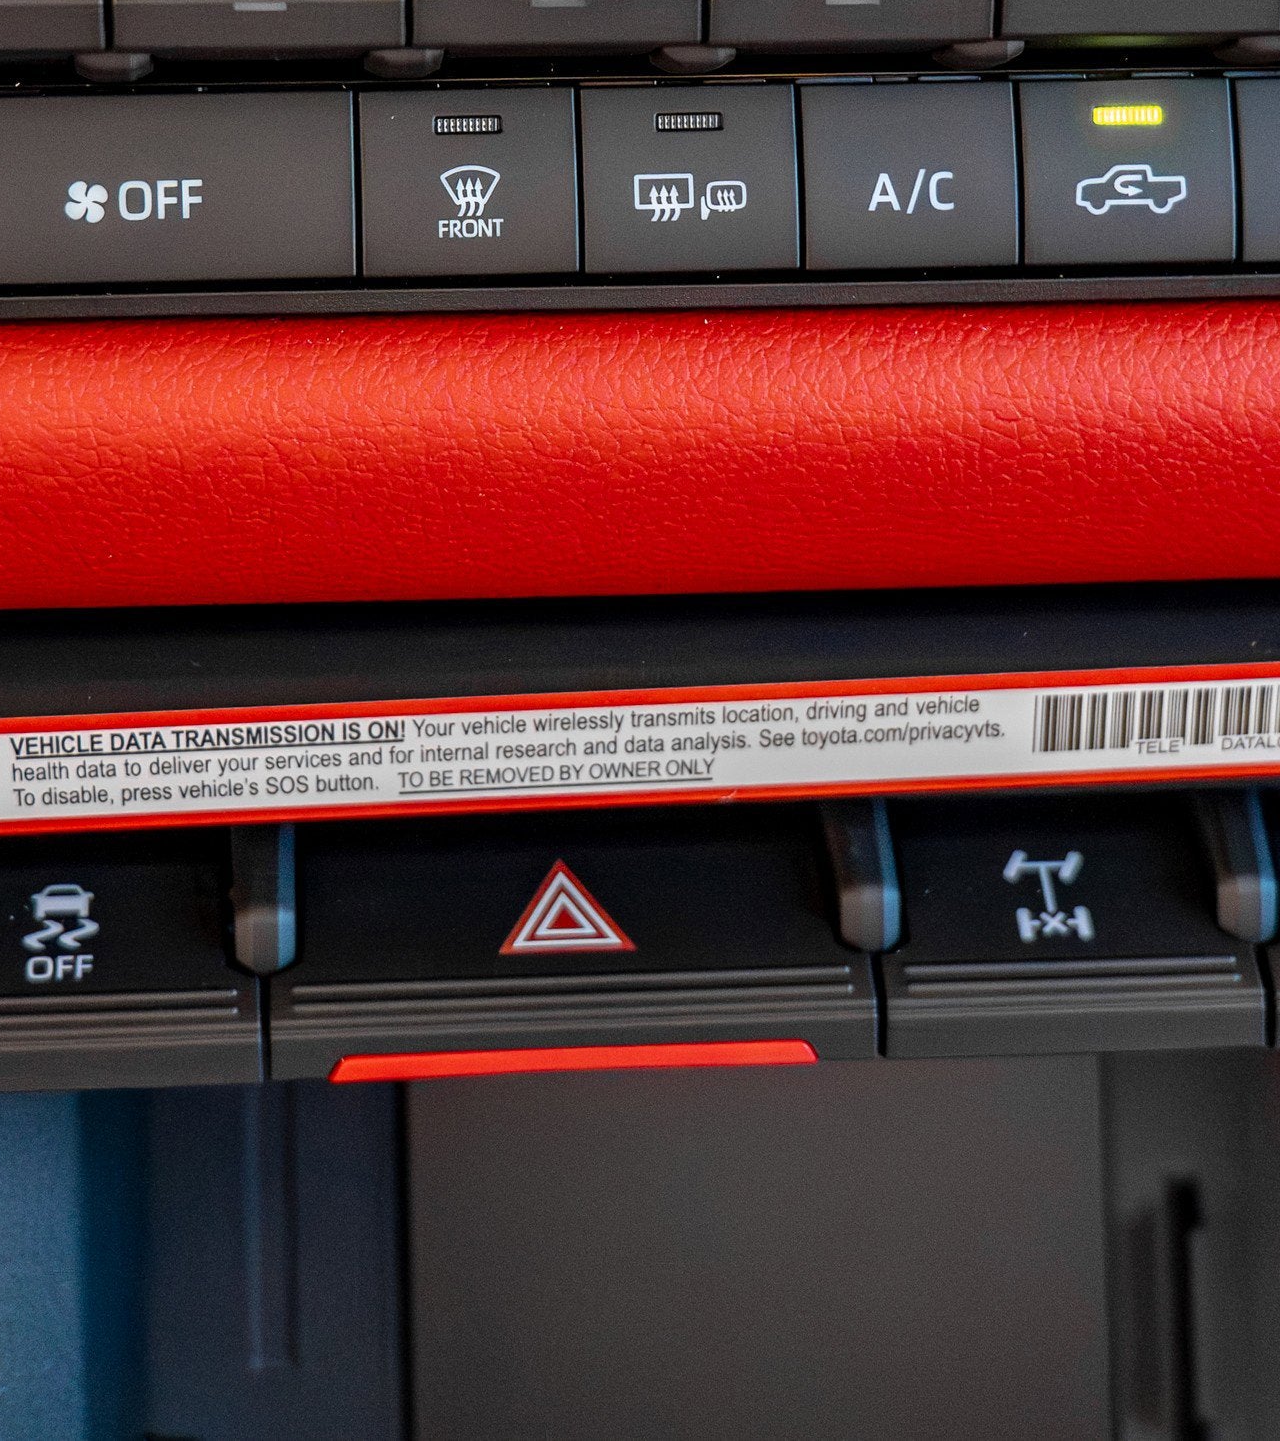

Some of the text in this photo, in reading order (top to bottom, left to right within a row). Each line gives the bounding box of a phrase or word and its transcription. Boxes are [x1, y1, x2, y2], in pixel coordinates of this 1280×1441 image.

[119, 178, 204, 221] OFF
[868, 168, 955, 214] A/C
[438, 218, 505, 239] FRONT
[10, 696, 980, 756] VEHICLE DATA TRANSMISSION IS ON! Your vehicle wirelessly transmits location, driving and vehicle
[1136, 738, 1180, 755] TELE
[12, 720, 1005, 782] health data to deliver your services and for internal research and data analysis. See toyota.com/privacyvts.
[13, 758, 715, 807] To disable, press vehicle's SOS button. TO BE REMOVED BY OWNER ONLY
[25, 954, 94, 983] OFF
